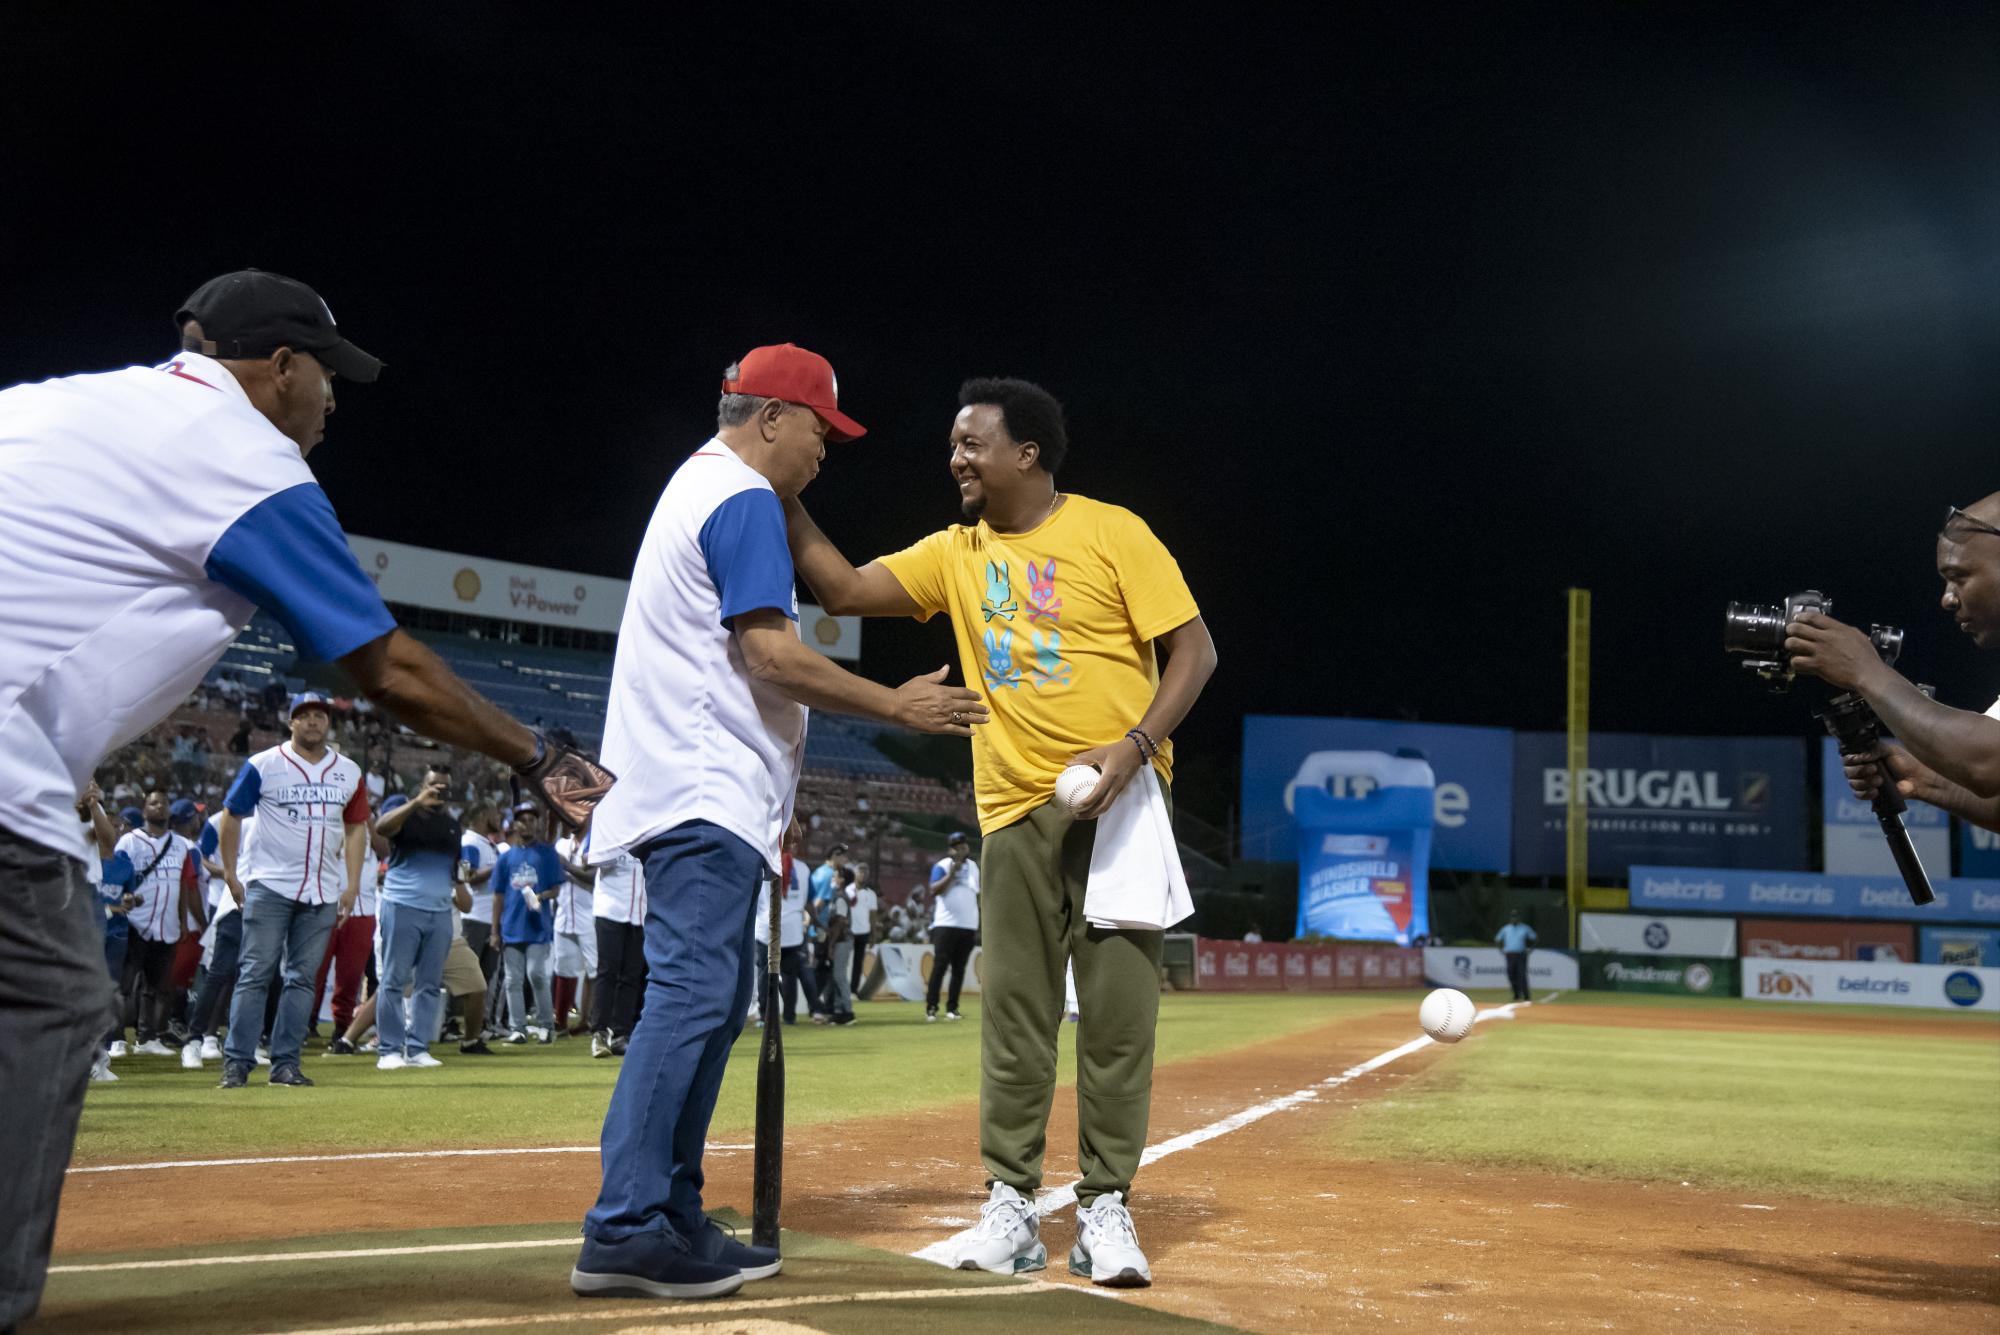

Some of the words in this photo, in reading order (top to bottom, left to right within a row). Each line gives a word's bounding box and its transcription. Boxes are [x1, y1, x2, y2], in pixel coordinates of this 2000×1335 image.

[510, 592, 580, 616] V-Power
[1543, 768, 1732, 810] BRUGAL
[1310, 878, 1370, 905] WASHER
[1643, 877, 1725, 900] betcris
[1749, 882, 1835, 905] betcris
[1758, 970, 1814, 998] BON
[1838, 976, 1910, 994] betcris
